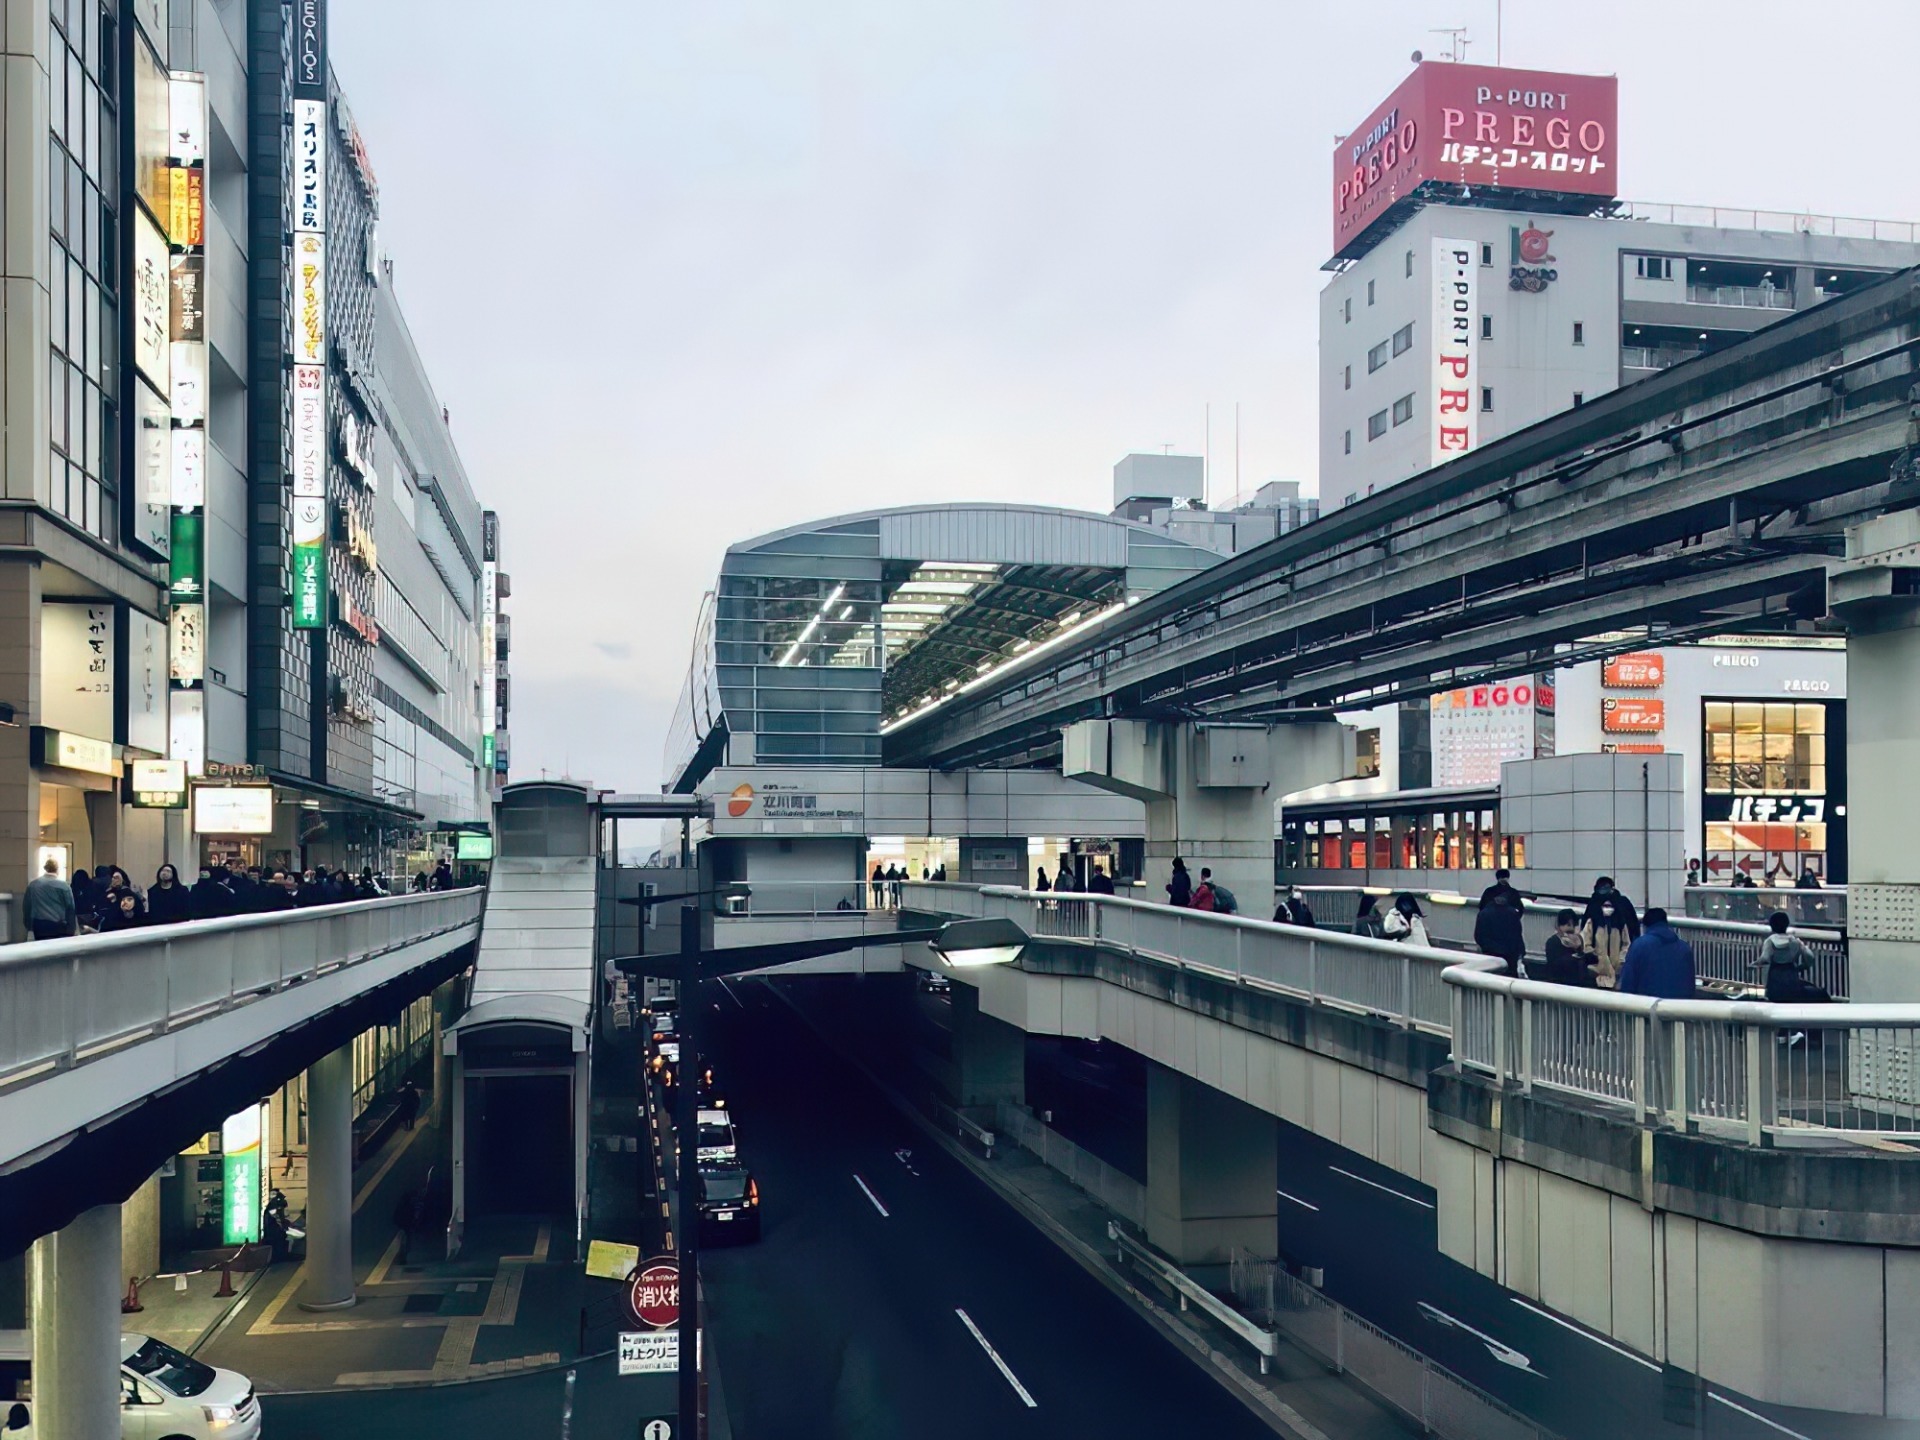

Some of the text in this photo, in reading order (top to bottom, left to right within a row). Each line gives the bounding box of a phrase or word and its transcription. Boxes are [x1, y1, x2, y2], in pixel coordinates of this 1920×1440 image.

[302, 0, 317, 80] EGALOS
[1340, 119, 1417, 214] PREGO
[1441, 107, 1605, 152] PREGO
